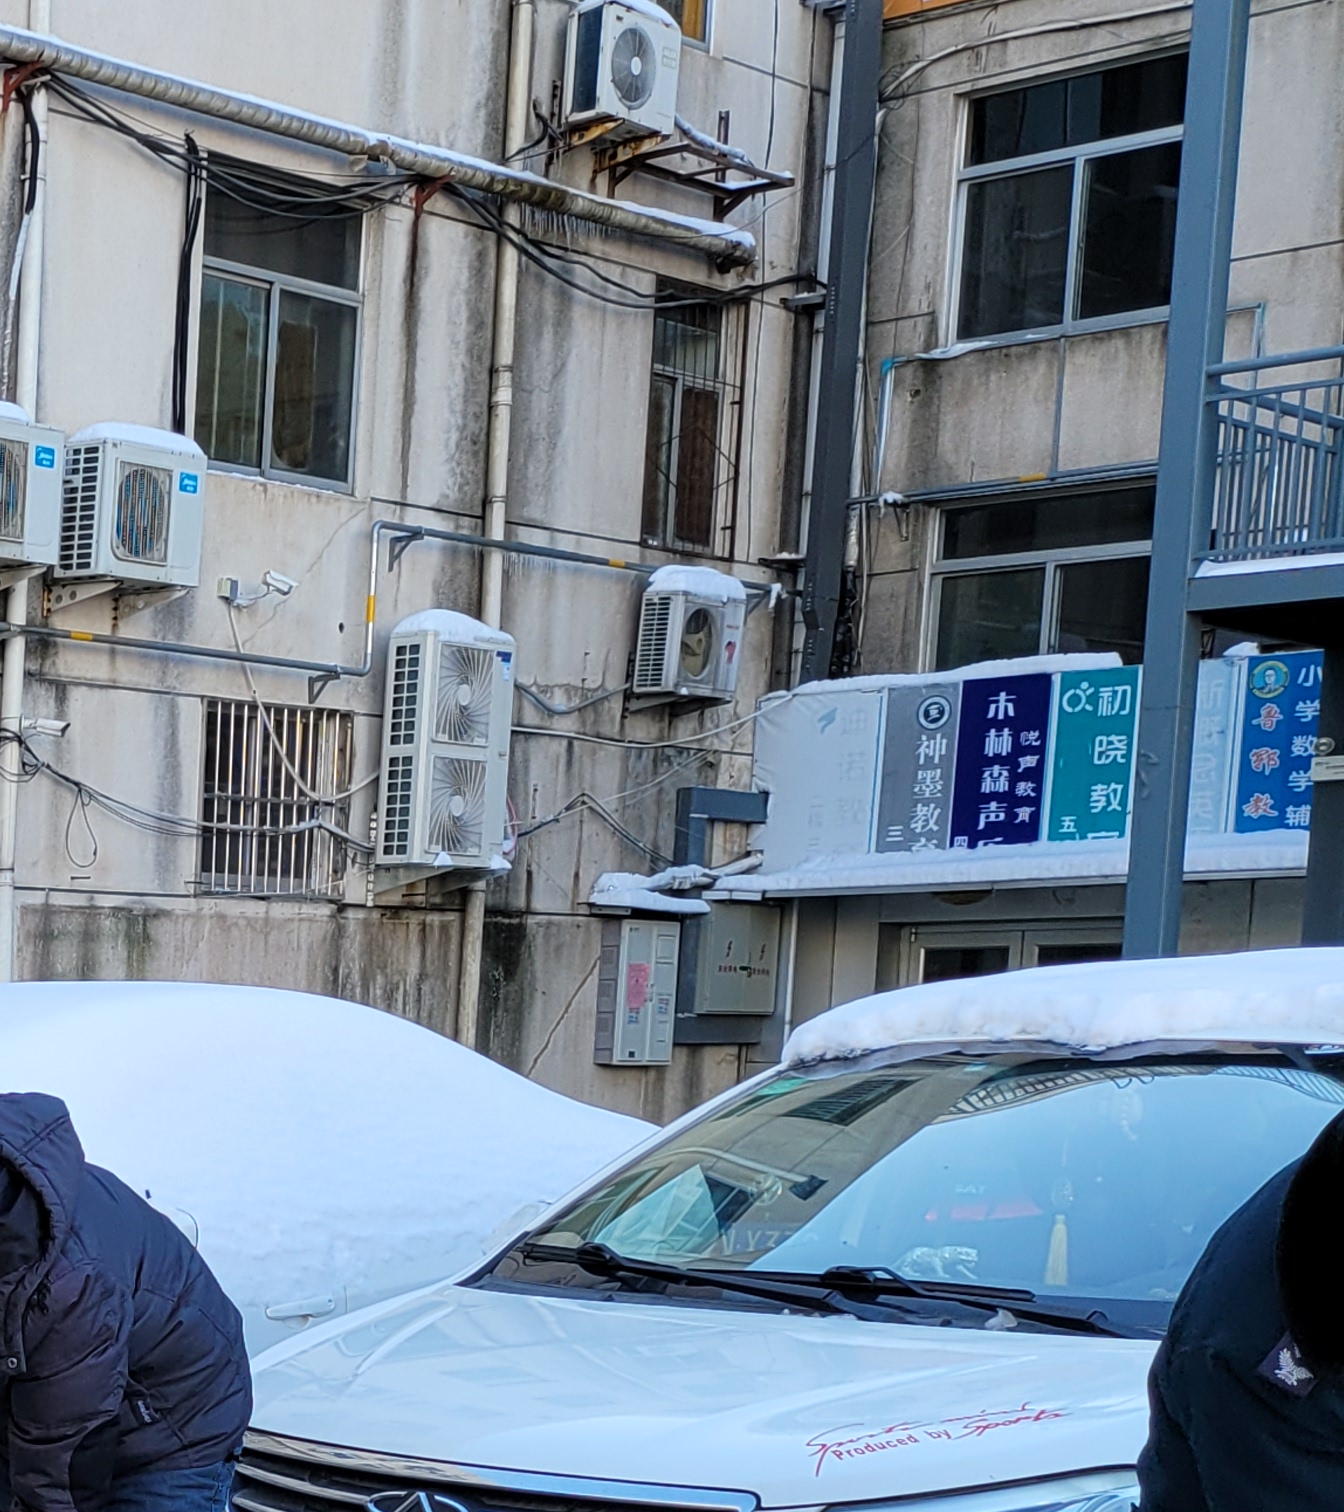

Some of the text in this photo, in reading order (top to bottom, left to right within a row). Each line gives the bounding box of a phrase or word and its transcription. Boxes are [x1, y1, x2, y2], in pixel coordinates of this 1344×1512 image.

[1013, 729, 1042, 824] 悦声教育
[885, 825, 905, 842] 三
[828, 1433, 922, 1461] Produced
[924, 1428, 953, 1441] by
